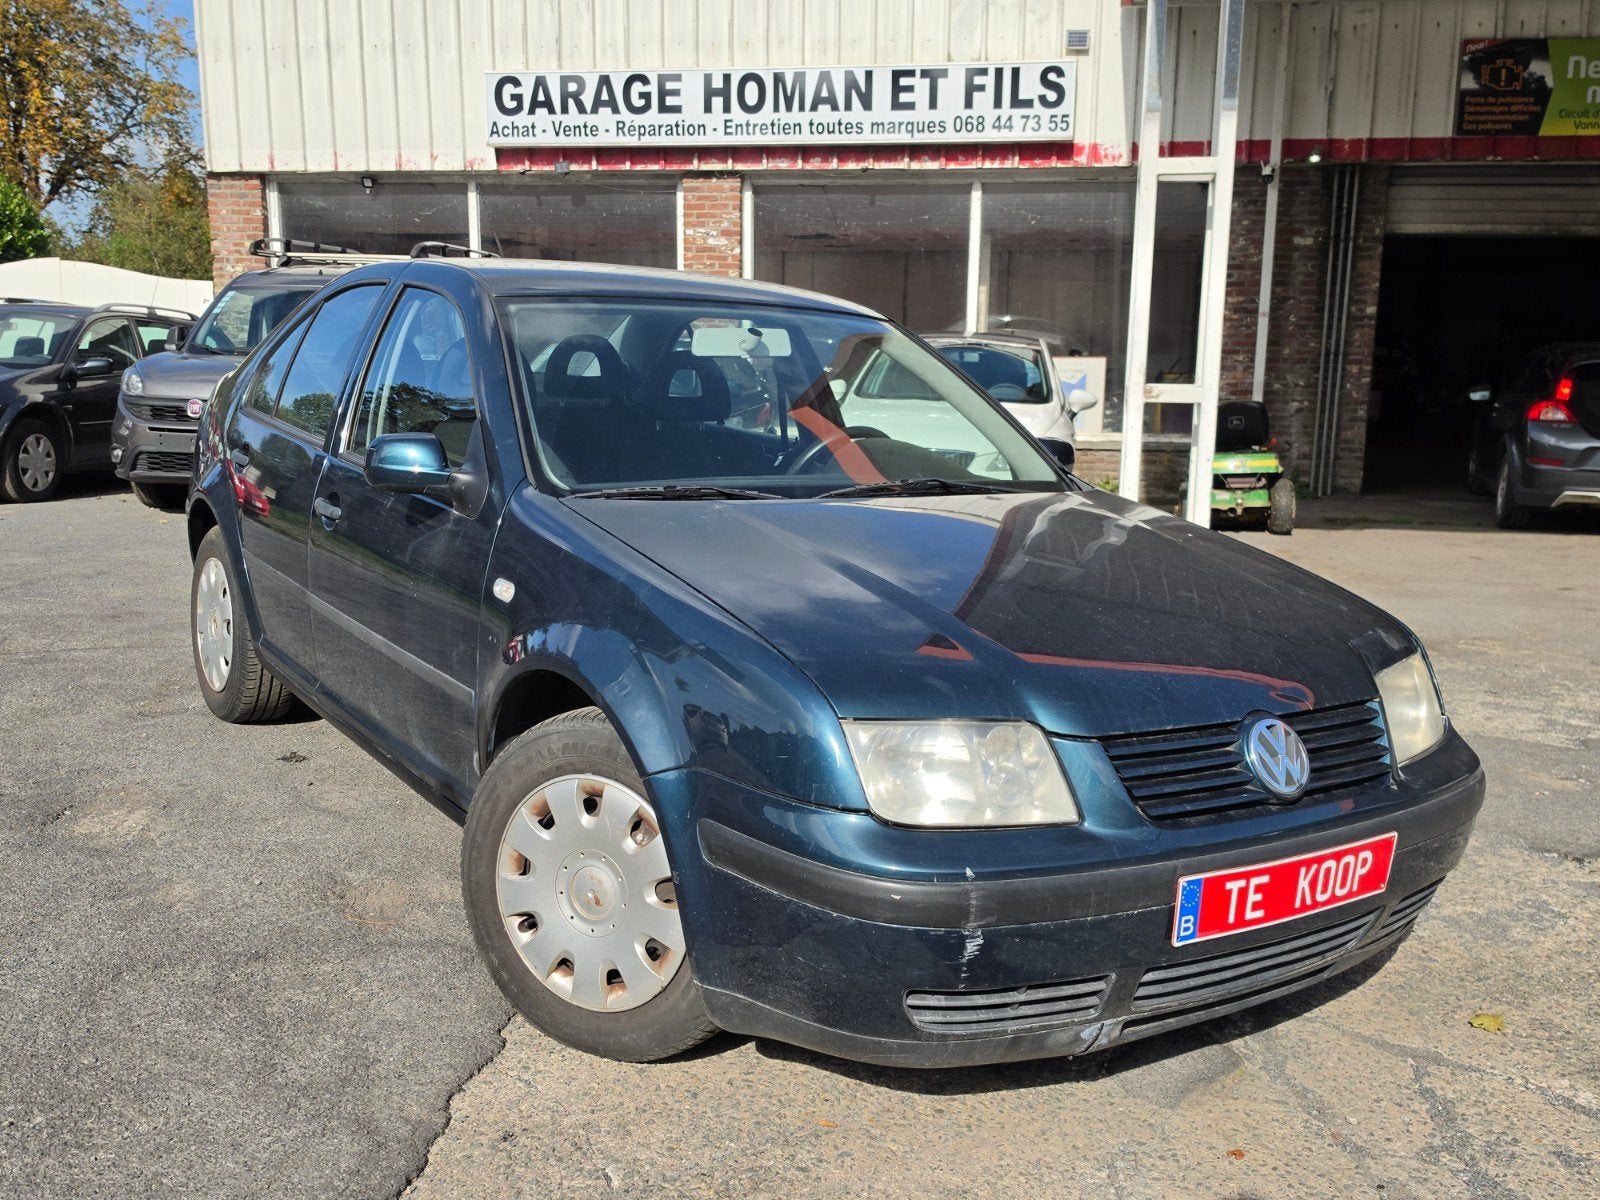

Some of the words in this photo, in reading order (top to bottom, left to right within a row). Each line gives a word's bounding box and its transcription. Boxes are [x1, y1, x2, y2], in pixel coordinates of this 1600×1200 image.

[494, 73, 683, 117] GARAGE
[703, 70, 873, 114] HOMAN
[891, 68, 949, 111] ET
[964, 65, 1067, 110] FILS
[1559, 108, 1590, 119] Circuit
[489, 121, 537, 138] Achat
[551, 120, 599, 138] Vente
[615, 119, 706, 141] Réparation
[723, 117, 802, 136] Entretien
[808, 118, 864, 135] toutes
[870, 118, 947, 138] marques
[953, 115, 985, 133] 068
[992, 115, 1014, 132] 44
[1020, 115, 1042, 132] 73
[1049, 114, 1070, 131] 55
[1225, 874, 1270, 924] TE
[1294, 850, 1373, 909] KOOP
[1180, 914, 1195, 937] B
